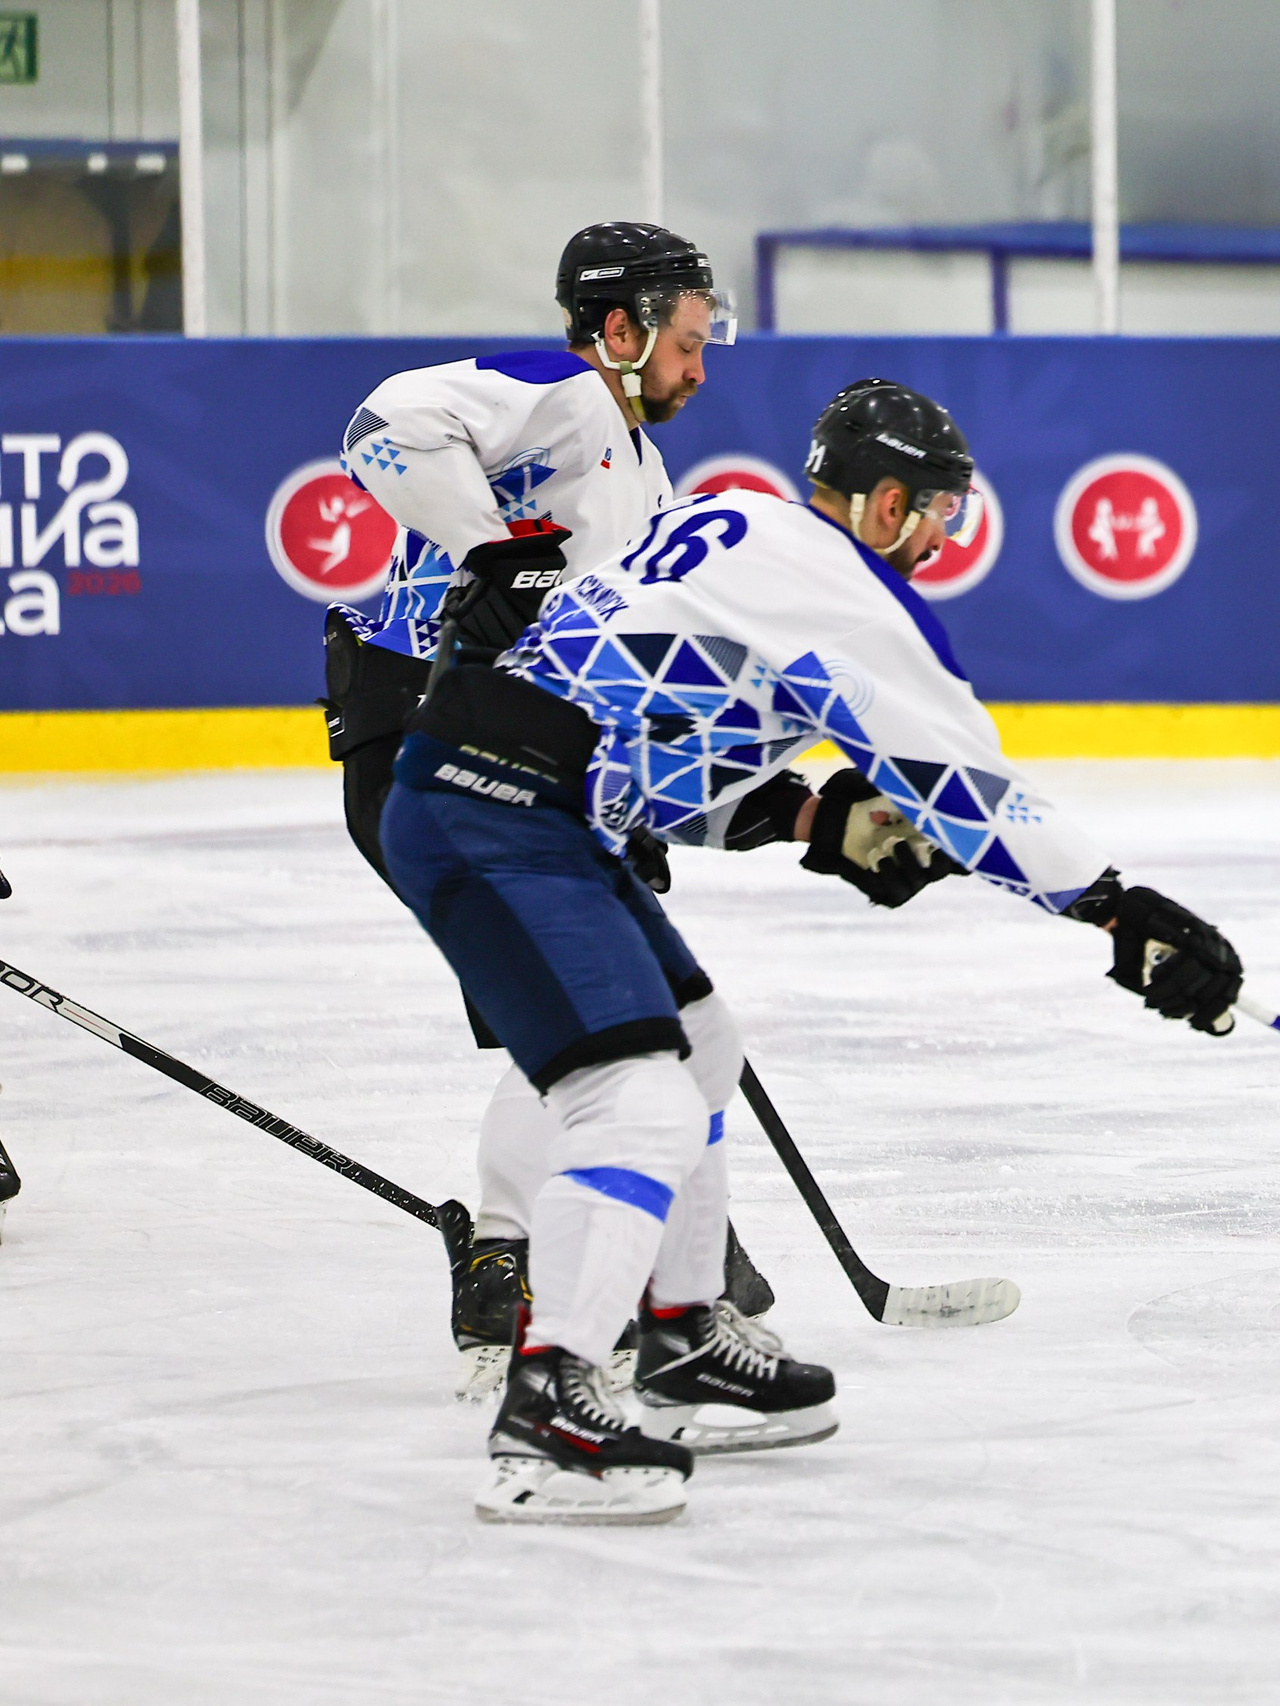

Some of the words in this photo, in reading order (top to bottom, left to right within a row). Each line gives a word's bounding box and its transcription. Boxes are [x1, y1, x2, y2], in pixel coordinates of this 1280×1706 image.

[875, 433, 928, 459] BAUER
[67, 569, 142, 596] 2026
[434, 763, 538, 807] BAUER
[0, 961, 64, 1014] OR
[200, 1082, 355, 1174] BAUER
[697, 1373, 755, 1397] BAUER
[549, 1415, 605, 1444] BAUER
